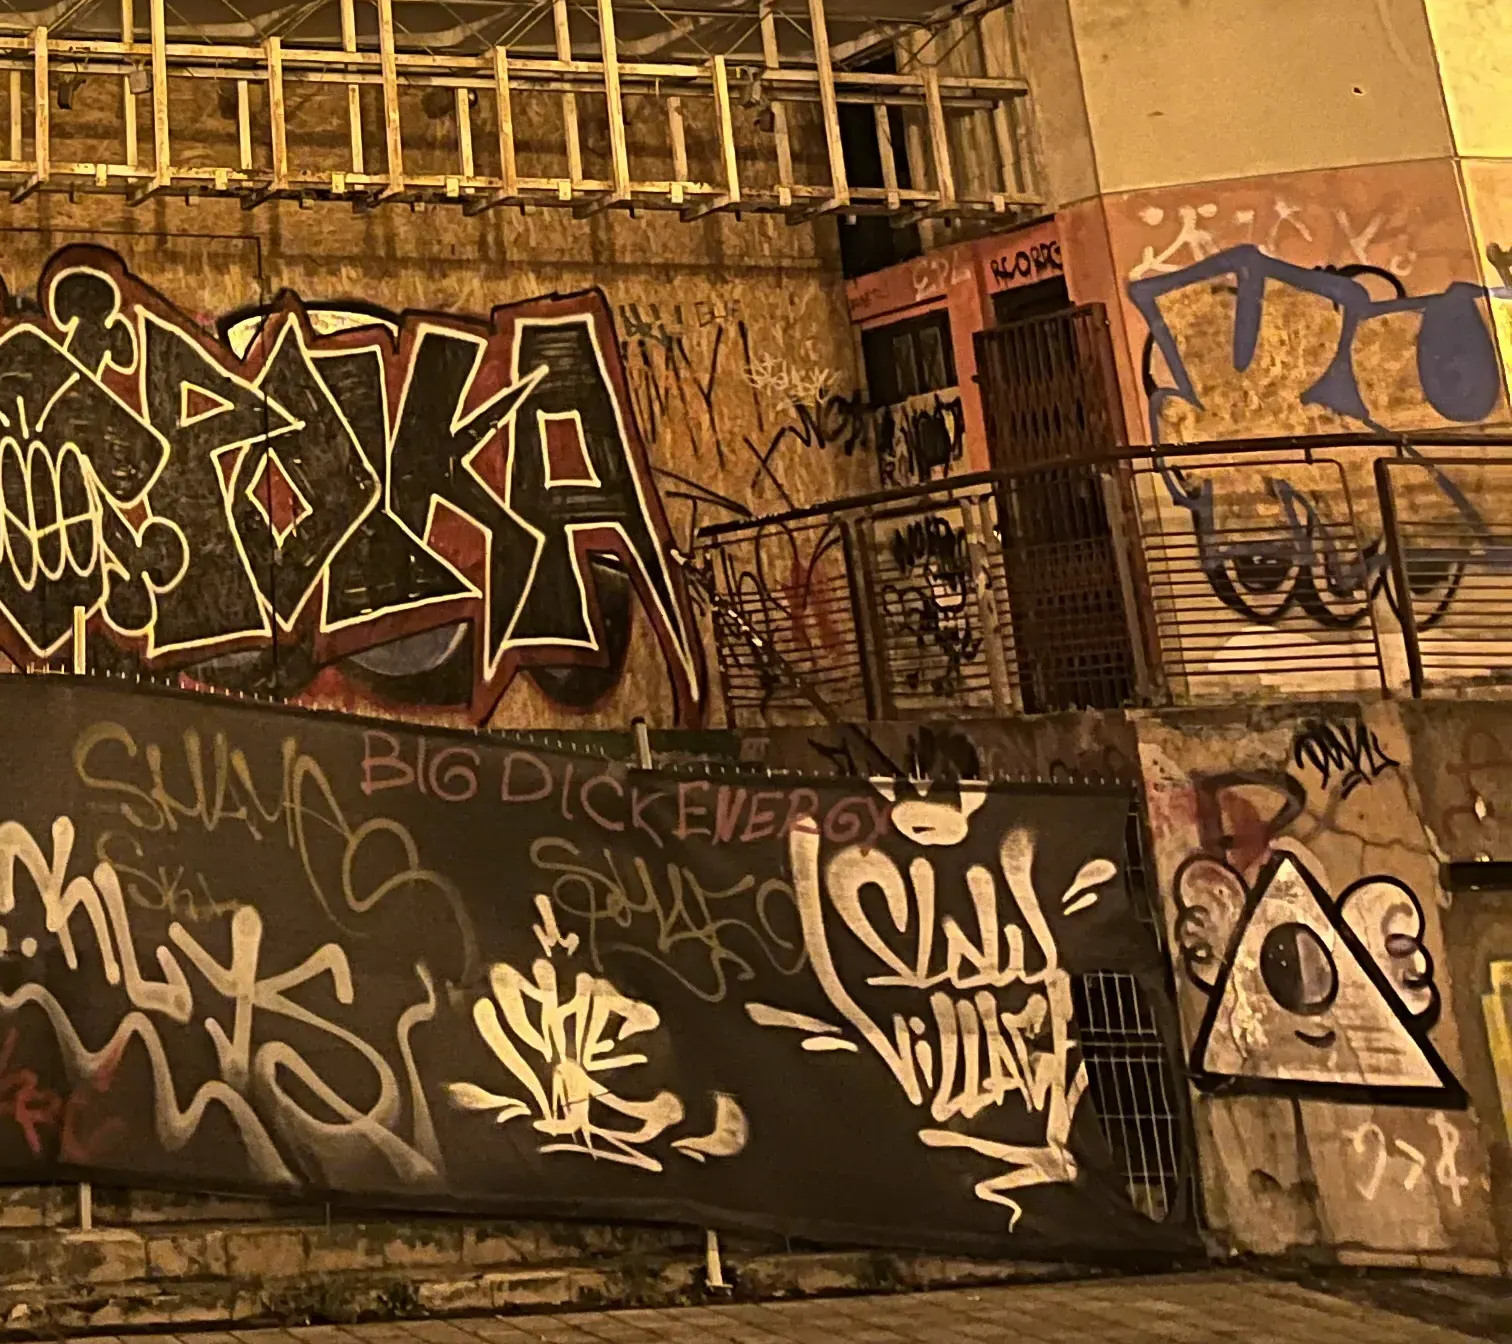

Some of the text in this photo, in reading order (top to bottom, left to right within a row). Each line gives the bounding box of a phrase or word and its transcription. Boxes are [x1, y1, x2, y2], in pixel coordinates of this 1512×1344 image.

[360, 729, 892, 857] BIG DICK ENERGY
